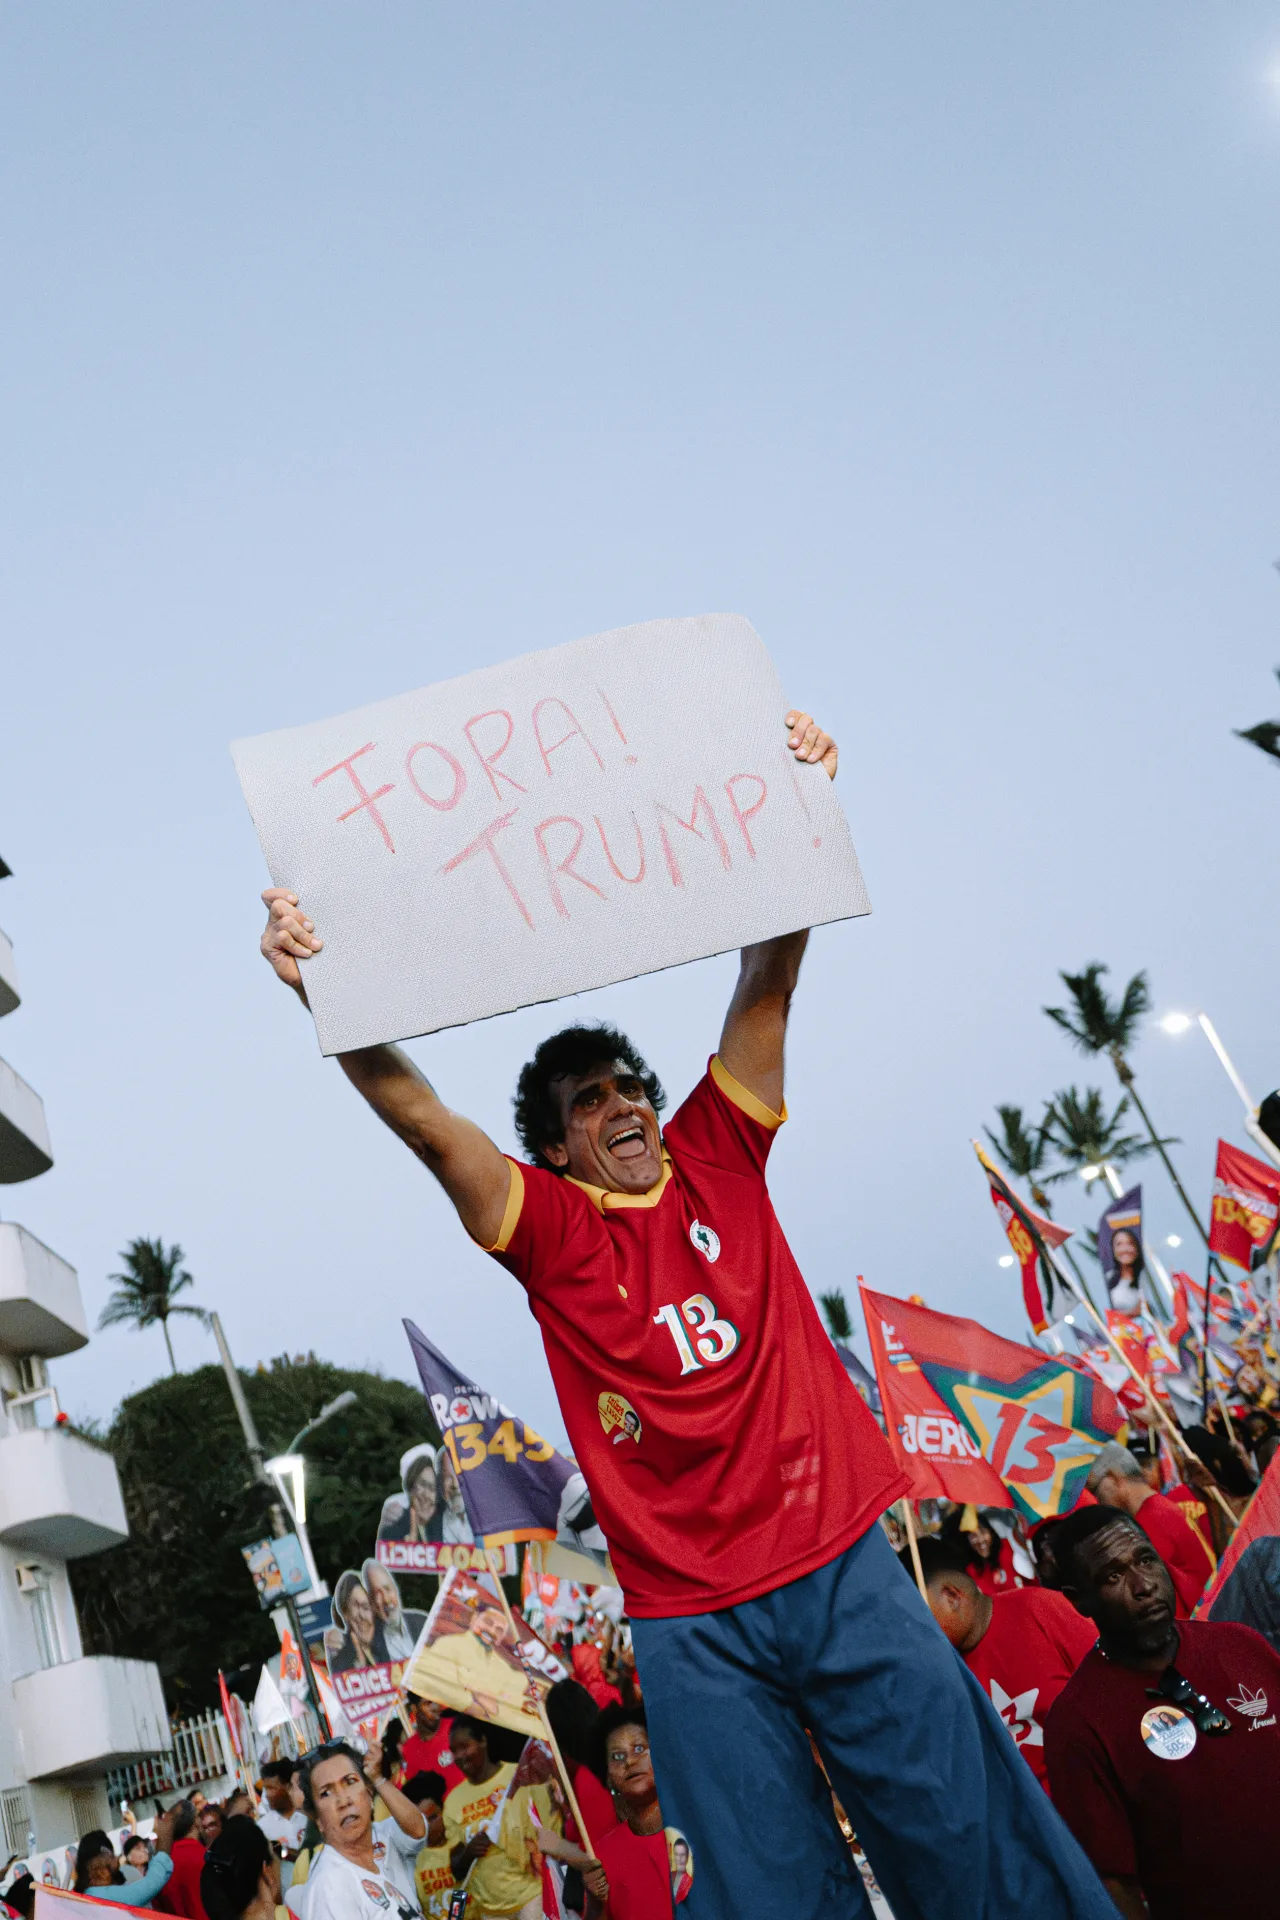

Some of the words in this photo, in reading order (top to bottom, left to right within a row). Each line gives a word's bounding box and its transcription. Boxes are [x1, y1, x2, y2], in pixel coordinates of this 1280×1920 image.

[311, 688, 638, 854] FORA!
[435, 750, 822, 931] TRUMP!
[652, 1293, 741, 1376] 13
[991, 1402, 1074, 1485] 13
